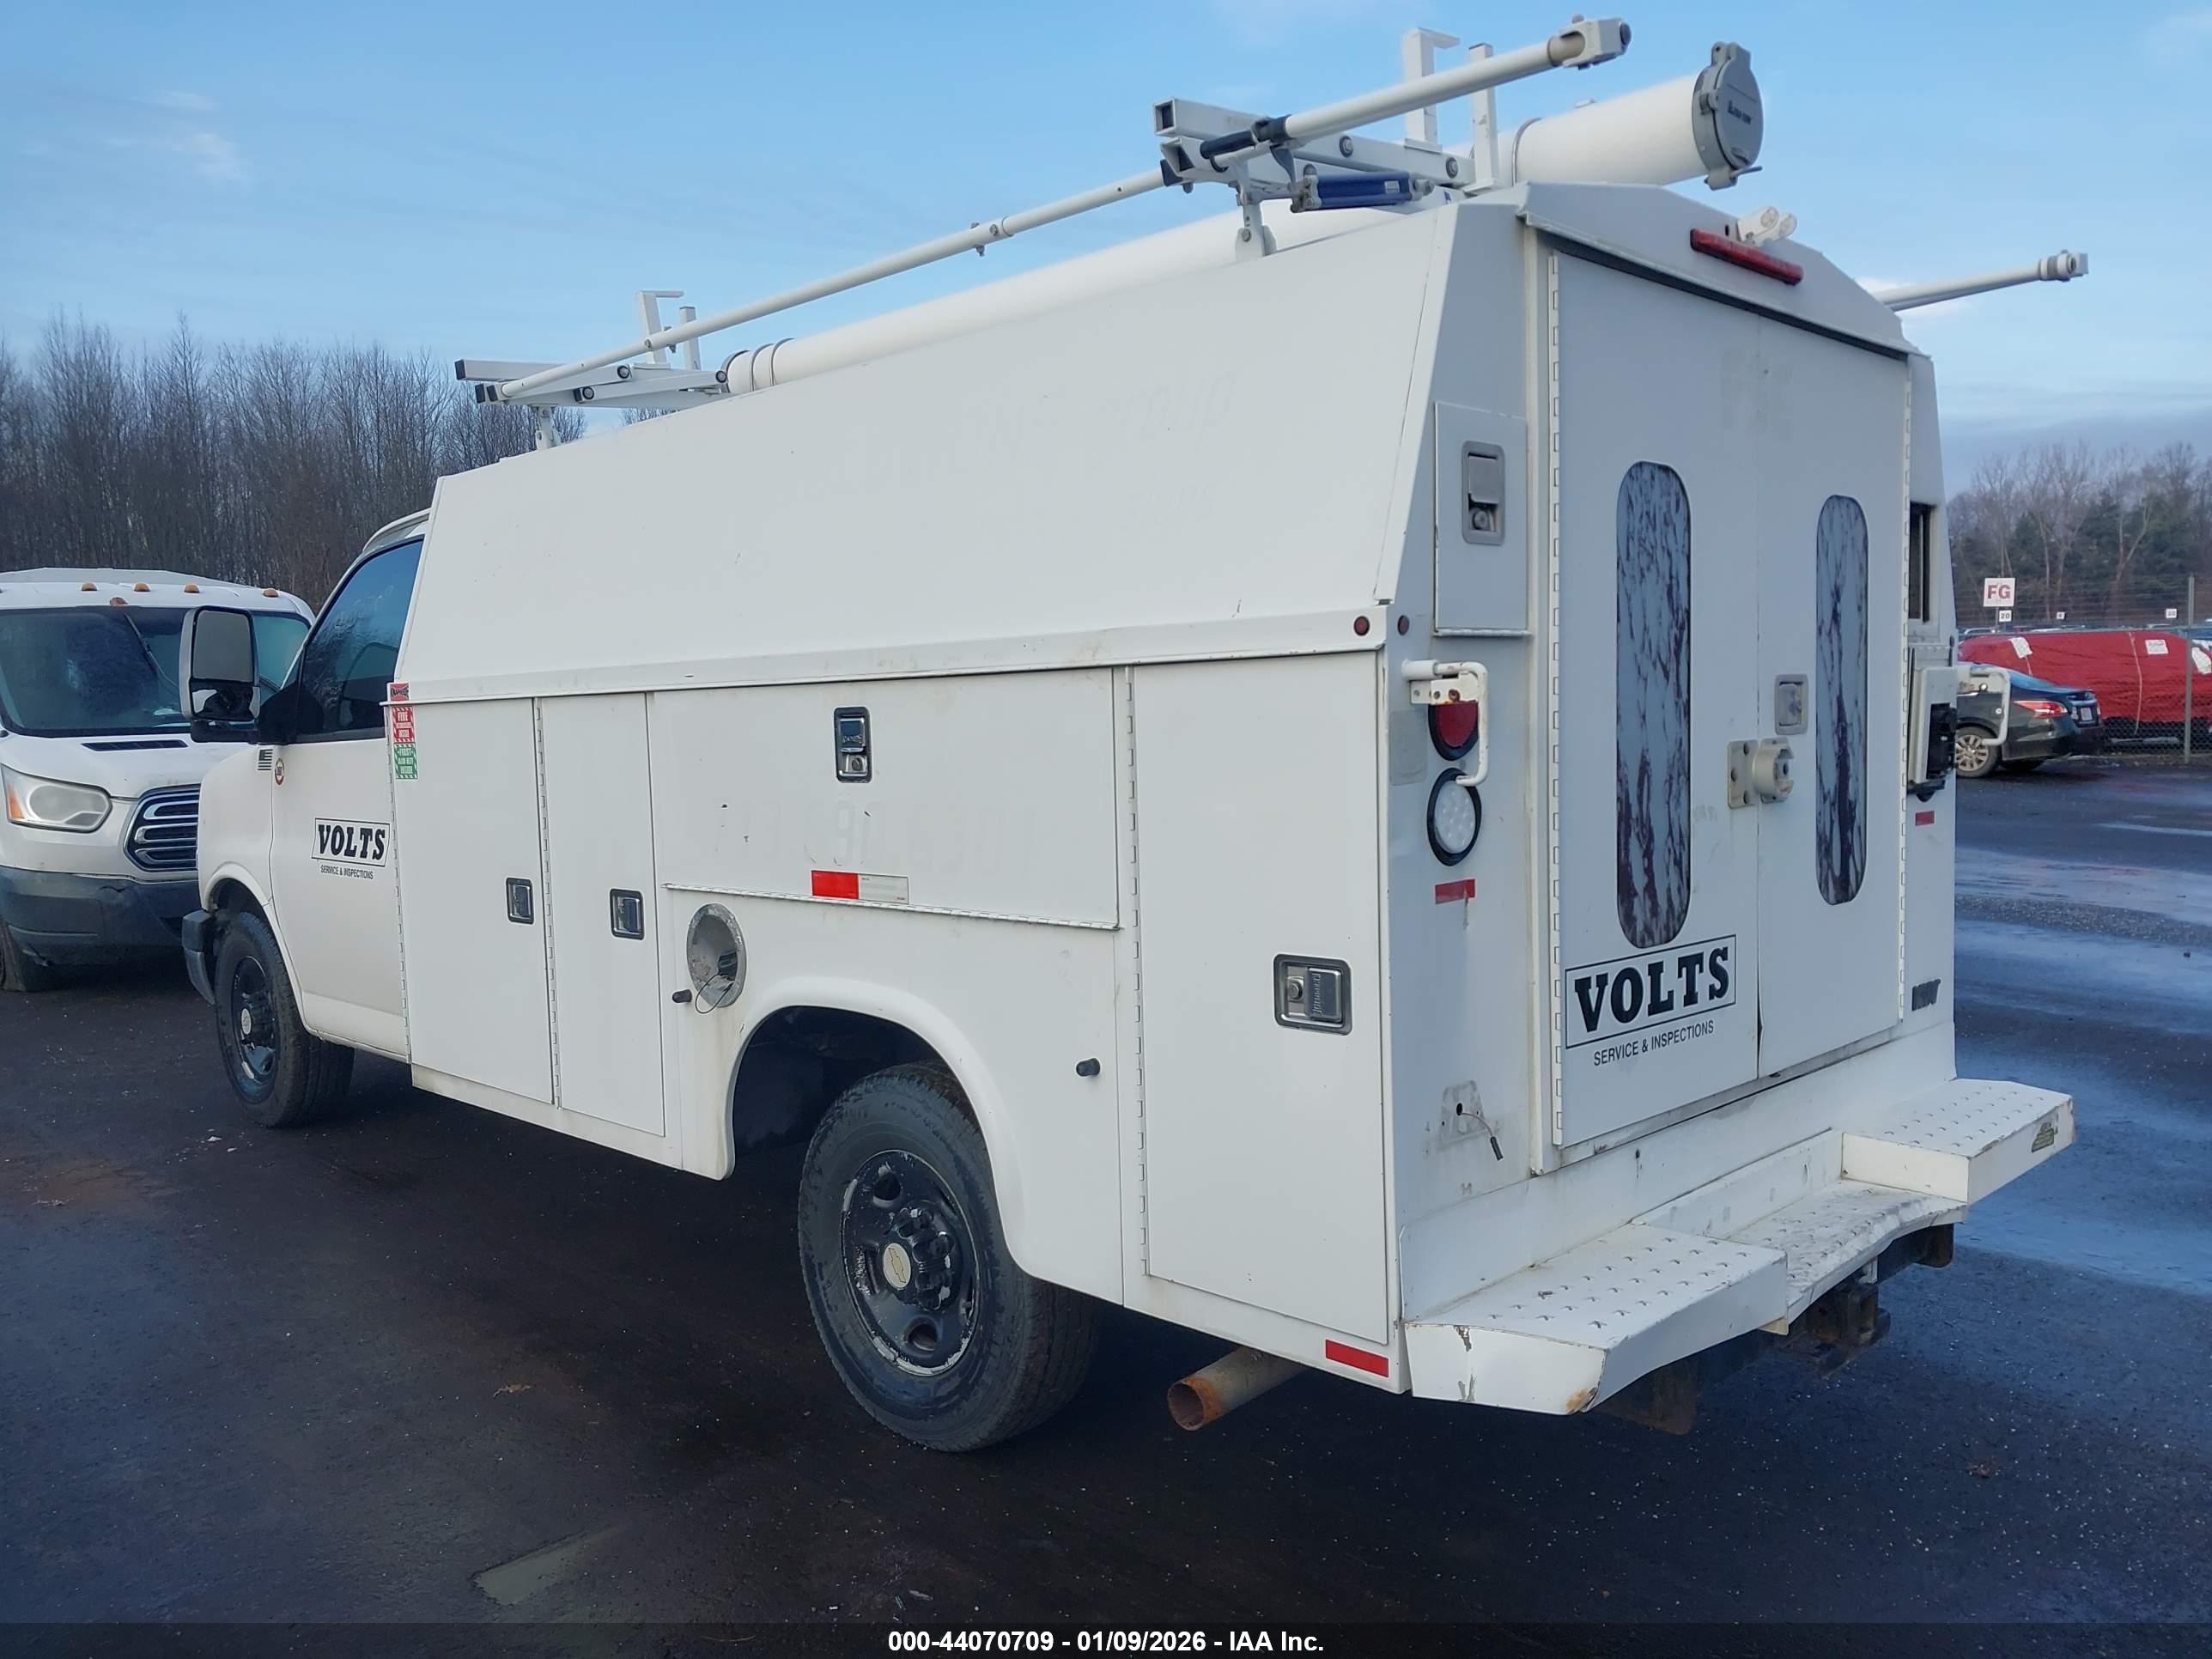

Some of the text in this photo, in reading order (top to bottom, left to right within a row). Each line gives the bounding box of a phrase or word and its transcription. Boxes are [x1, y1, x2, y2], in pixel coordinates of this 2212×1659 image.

[1987, 584, 2011, 599] FG
[318, 823, 386, 860] VOLTS
[320, 864, 338, 875] SERVICE
[343, 868, 374, 879] INSPECTIONS
[1574, 946, 1729, 1033] VOLTS
[1594, 1019, 1714, 1066] SERVICE & INSPECTIONS
